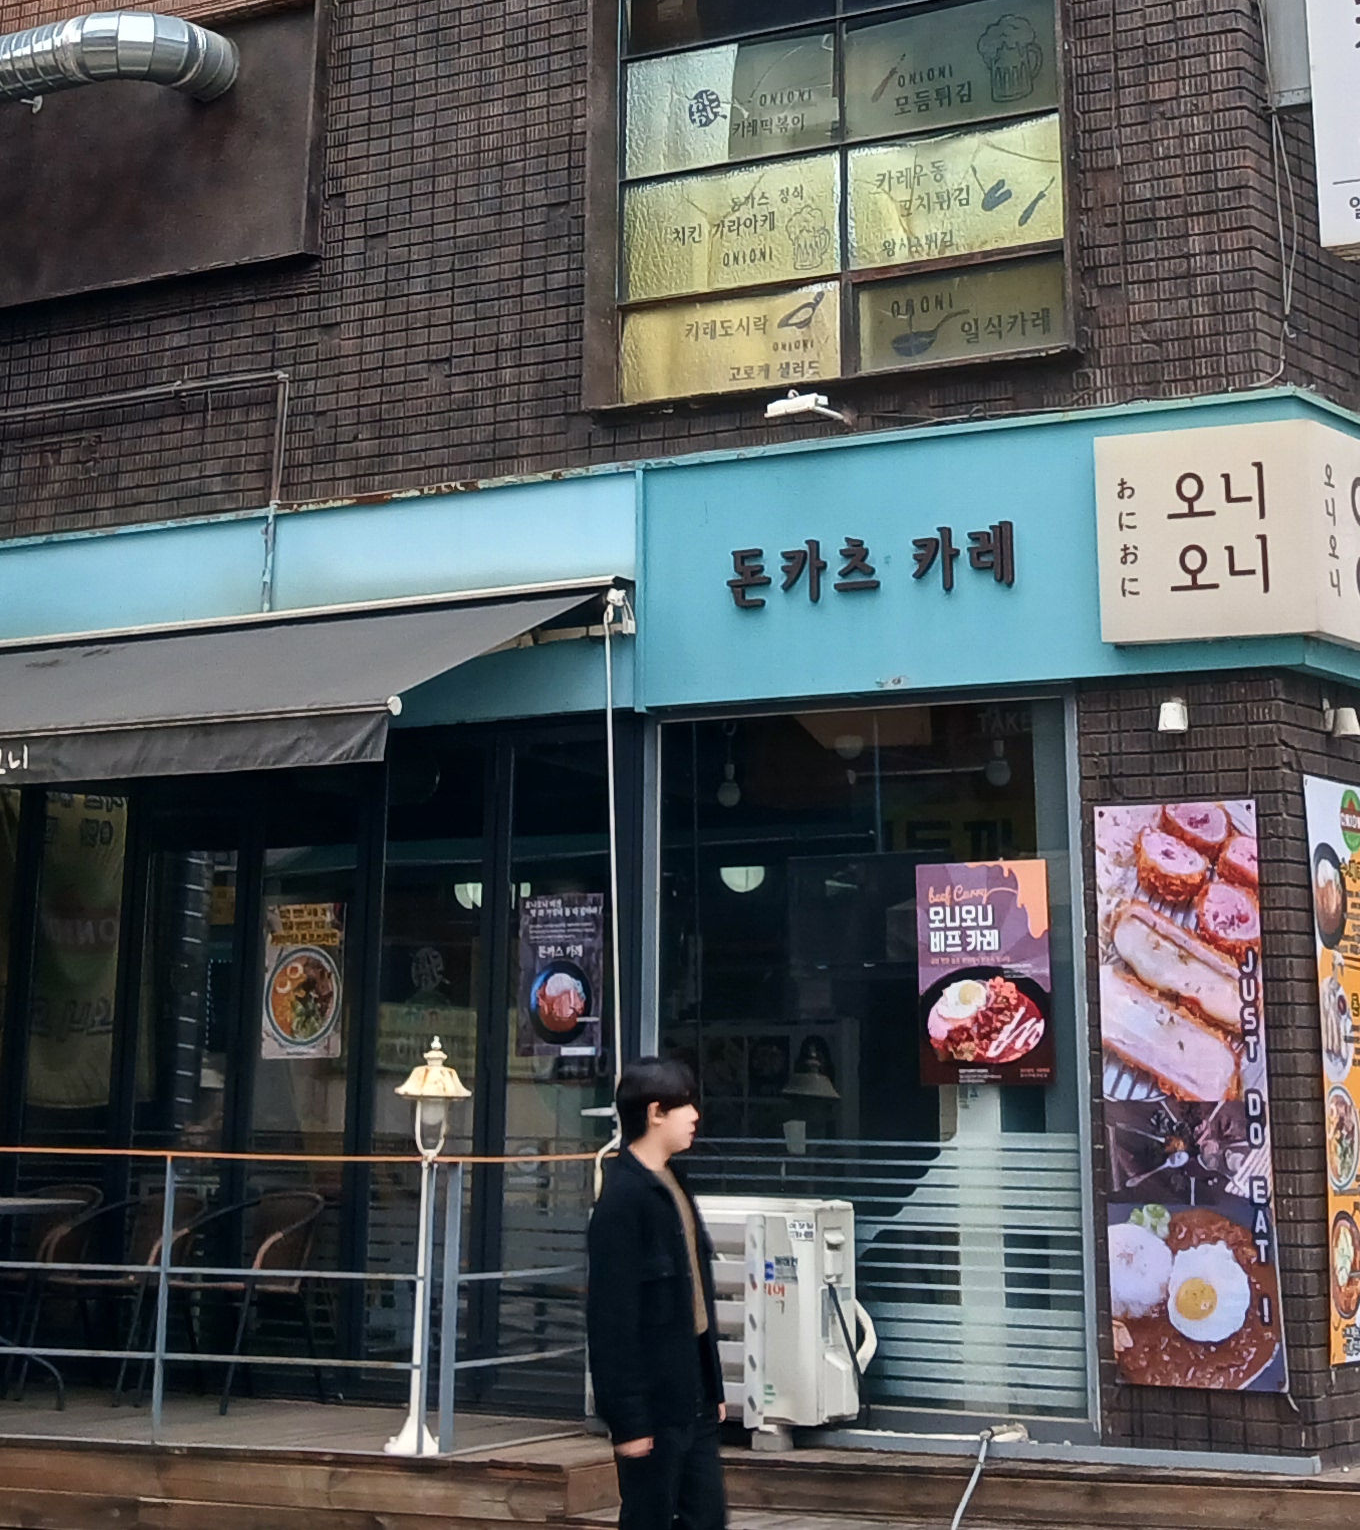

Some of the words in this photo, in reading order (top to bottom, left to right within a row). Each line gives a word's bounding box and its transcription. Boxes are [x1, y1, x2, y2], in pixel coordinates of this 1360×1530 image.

[895, 80, 972, 116] 모듬튀김
[732, 113, 805, 139] 카레떡볶이
[875, 160, 947, 192] 카레우동
[673, 224, 702, 246] 치킨
[961, 307, 1051, 344] 일식카레
[1167, 461, 1267, 521] 오니
[1117, 477, 1142, 599] おにおに
[727, 537, 881, 608] 돈카츠
[912, 520, 1015, 592] 카레
[1170, 533, 1270, 594] 오니
[929, 905, 993, 928] 오니오니
[930, 931, 962, 953] 비프
[966, 930, 999, 951] 카레
[1242, 950, 1259, 1061] JUST
[1247, 1092, 1263, 1145] DO
[1253, 1180, 1269, 1264] EAT
